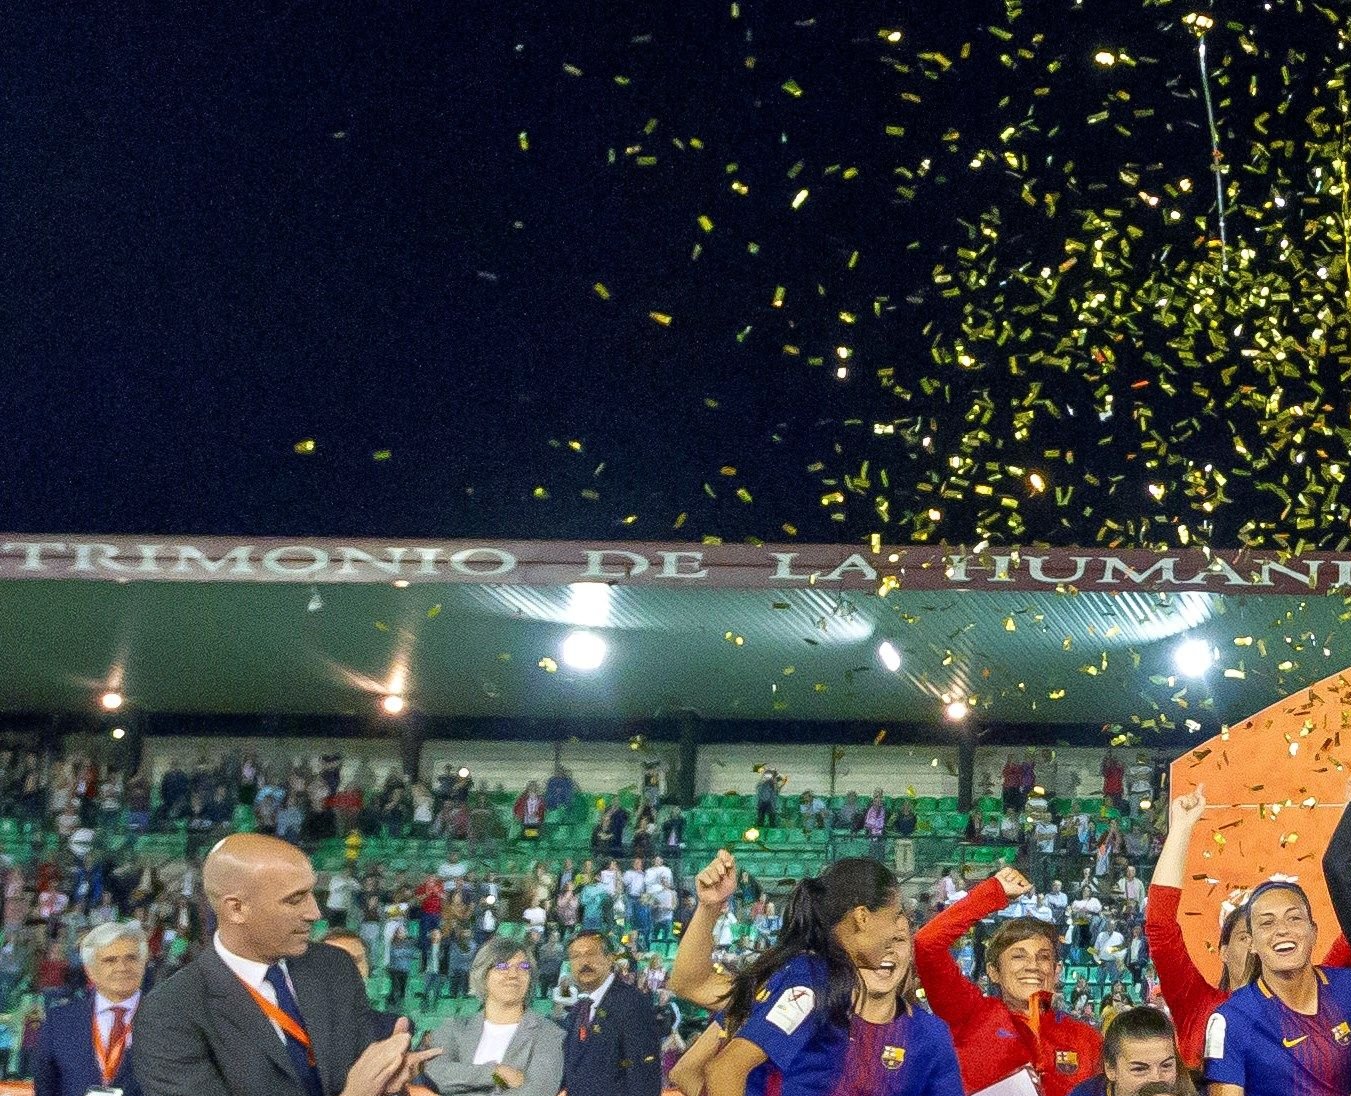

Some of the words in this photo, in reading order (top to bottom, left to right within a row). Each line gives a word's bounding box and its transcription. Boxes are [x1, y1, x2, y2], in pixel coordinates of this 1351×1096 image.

[3, 542, 518, 576] TRIMONIO
[581, 550, 708, 580] DE
[768, 552, 878, 582] LA
